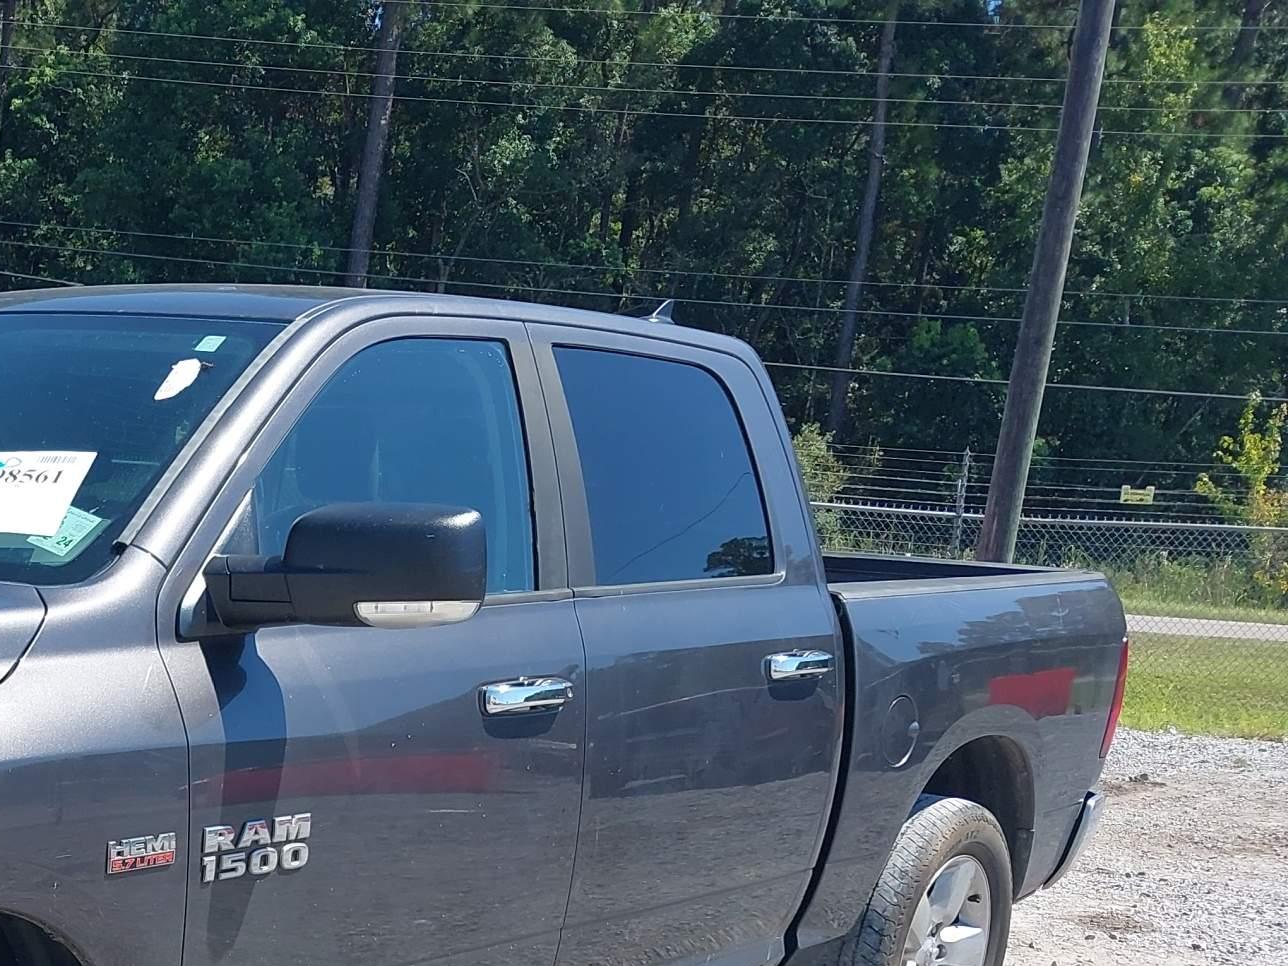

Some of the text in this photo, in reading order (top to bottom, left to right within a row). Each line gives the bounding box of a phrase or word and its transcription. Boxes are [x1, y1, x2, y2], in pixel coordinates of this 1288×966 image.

[55, 536, 73, 548] 24
[108, 832, 176, 858] HEMI
[203, 812, 312, 854] RAM
[112, 850, 173, 872] 5.7 LITER
[201, 842, 310, 883] 1500
